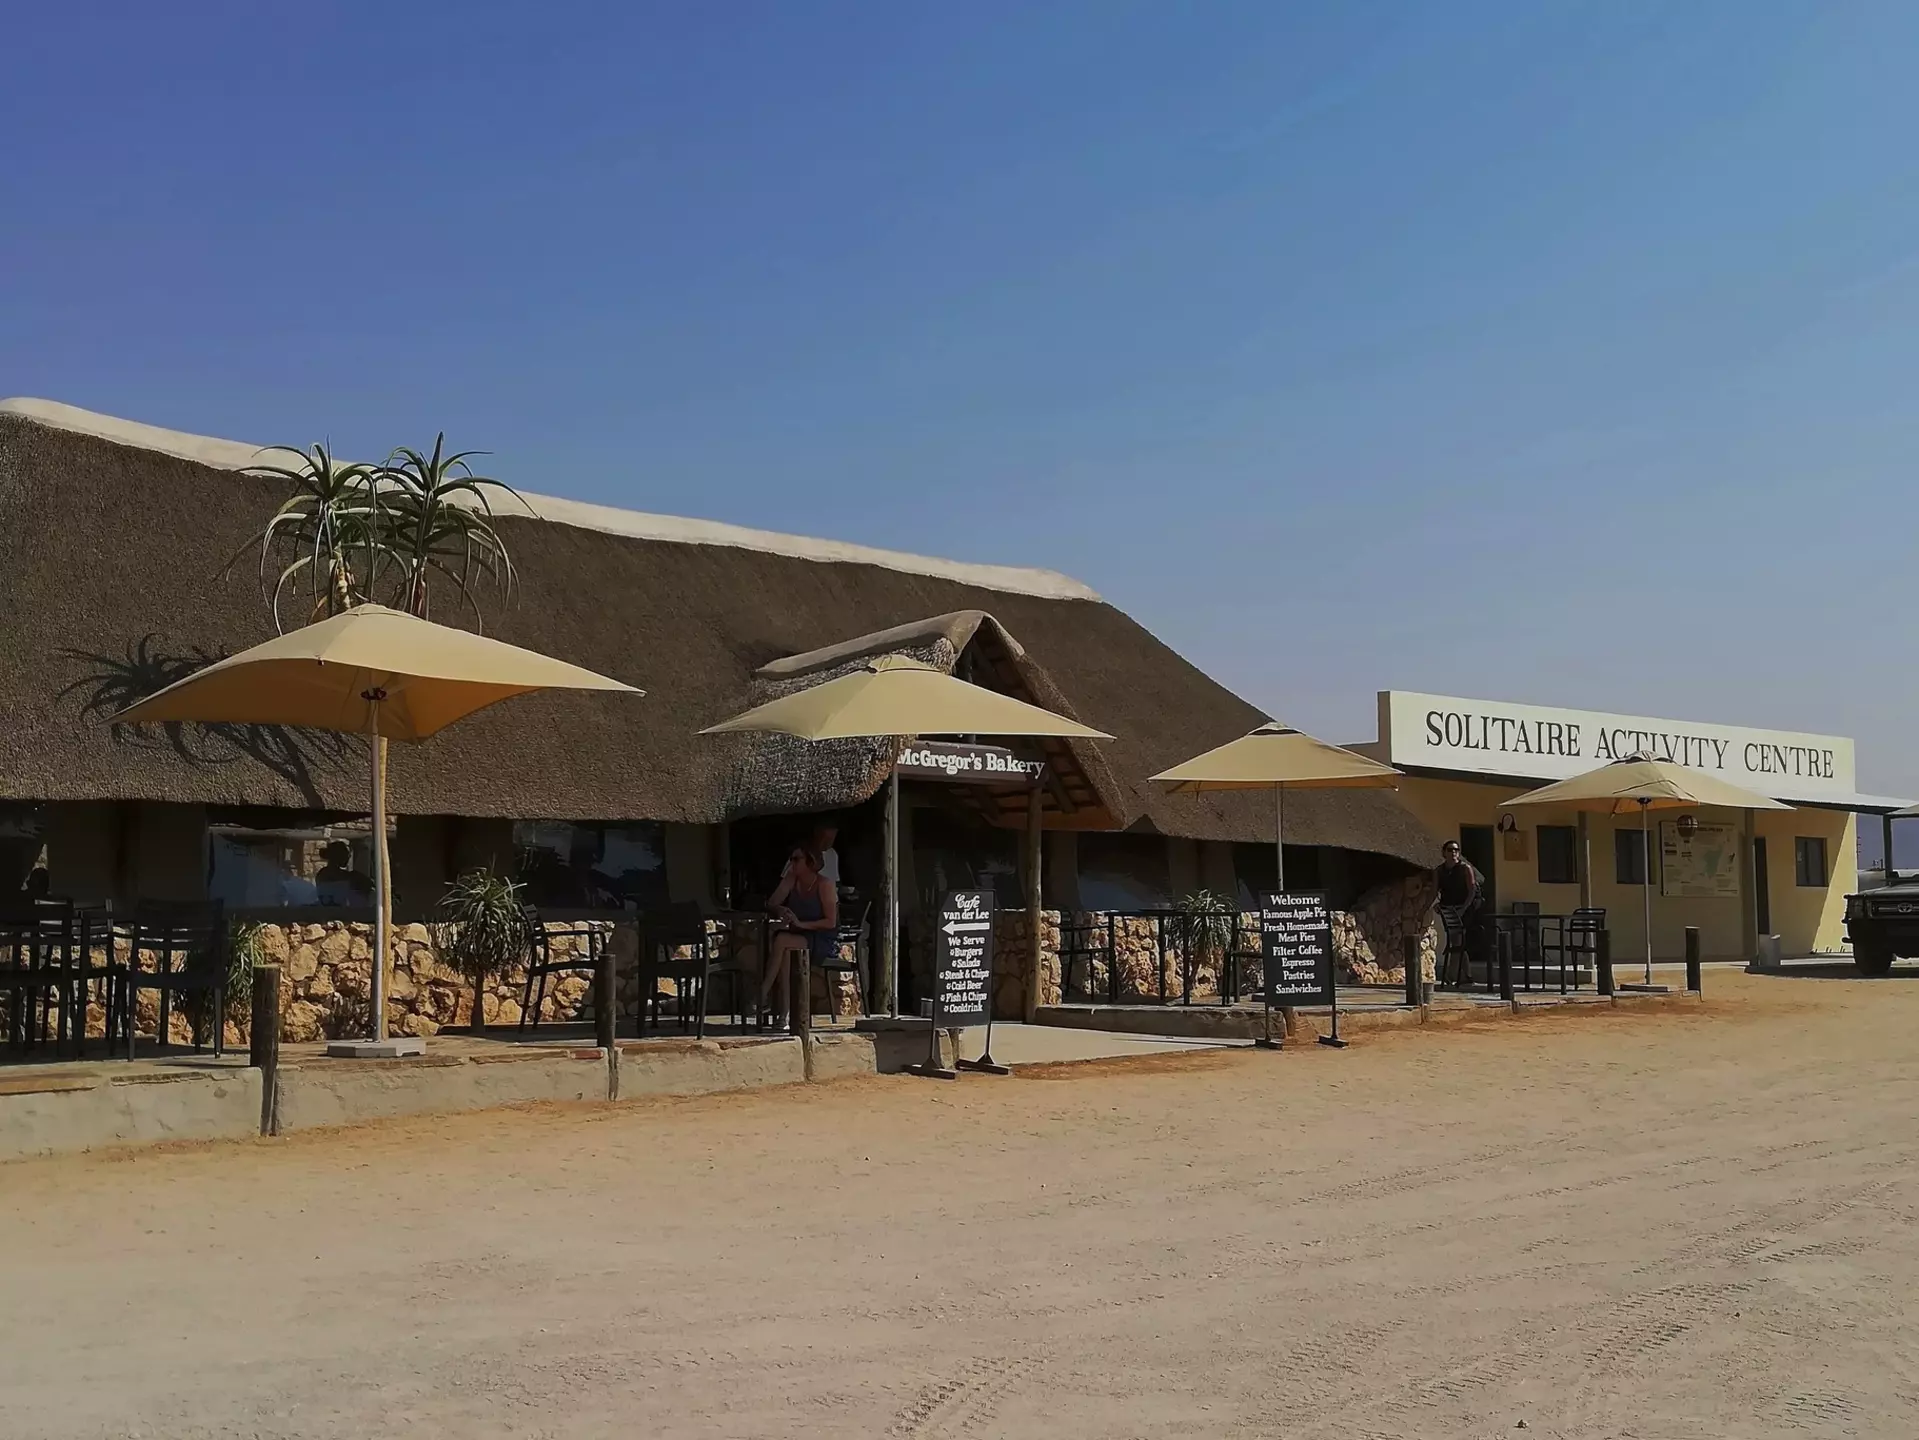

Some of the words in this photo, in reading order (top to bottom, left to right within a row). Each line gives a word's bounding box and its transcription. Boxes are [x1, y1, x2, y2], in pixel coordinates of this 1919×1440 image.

[1426, 711, 1581, 756] SOLITAIRE
[1594, 727, 1730, 769] ACTIVITY
[1744, 743, 1834, 778] CENTRE
[897, 748, 982, 775] McGregor's
[986, 753, 1045, 779] Bakery
[1270, 894, 1320, 905] Welcome
[943, 911, 961, 920] van
[962, 908, 974, 920] der
[975, 908, 990, 920] Lee
[1263, 909, 1292, 919] Famous
[1293, 907, 1314, 920] Apple
[1314, 906, 1327, 917] Pie
[1264, 922, 1285, 932] Fresh
[1286, 919, 1329, 931] Homemade
[948, 937, 961, 946] We
[963, 936, 985, 945] Serve
[1278, 932, 1298, 943] Meat
[1300, 931, 1316, 942] Pies
[954, 948, 983, 959] Burgers
[1272, 946, 1297, 956] Filter
[1298, 944, 1323, 955] Coffee
[957, 957, 981, 968] Salads
[1281, 957, 1315, 969] Espresso
[945, 970, 964, 980] Steak
[965, 969, 970, 979] &
[971, 969, 990, 980] Chips
[1283, 970, 1315, 980] Pastries
[967, 981, 983, 990] Beer
[1275, 982, 1322, 994] Sandwiches
[946, 992, 961, 1002] Fish
[968, 992, 987, 1003] Chips
[950, 1002, 983, 1012] Cooldrink
